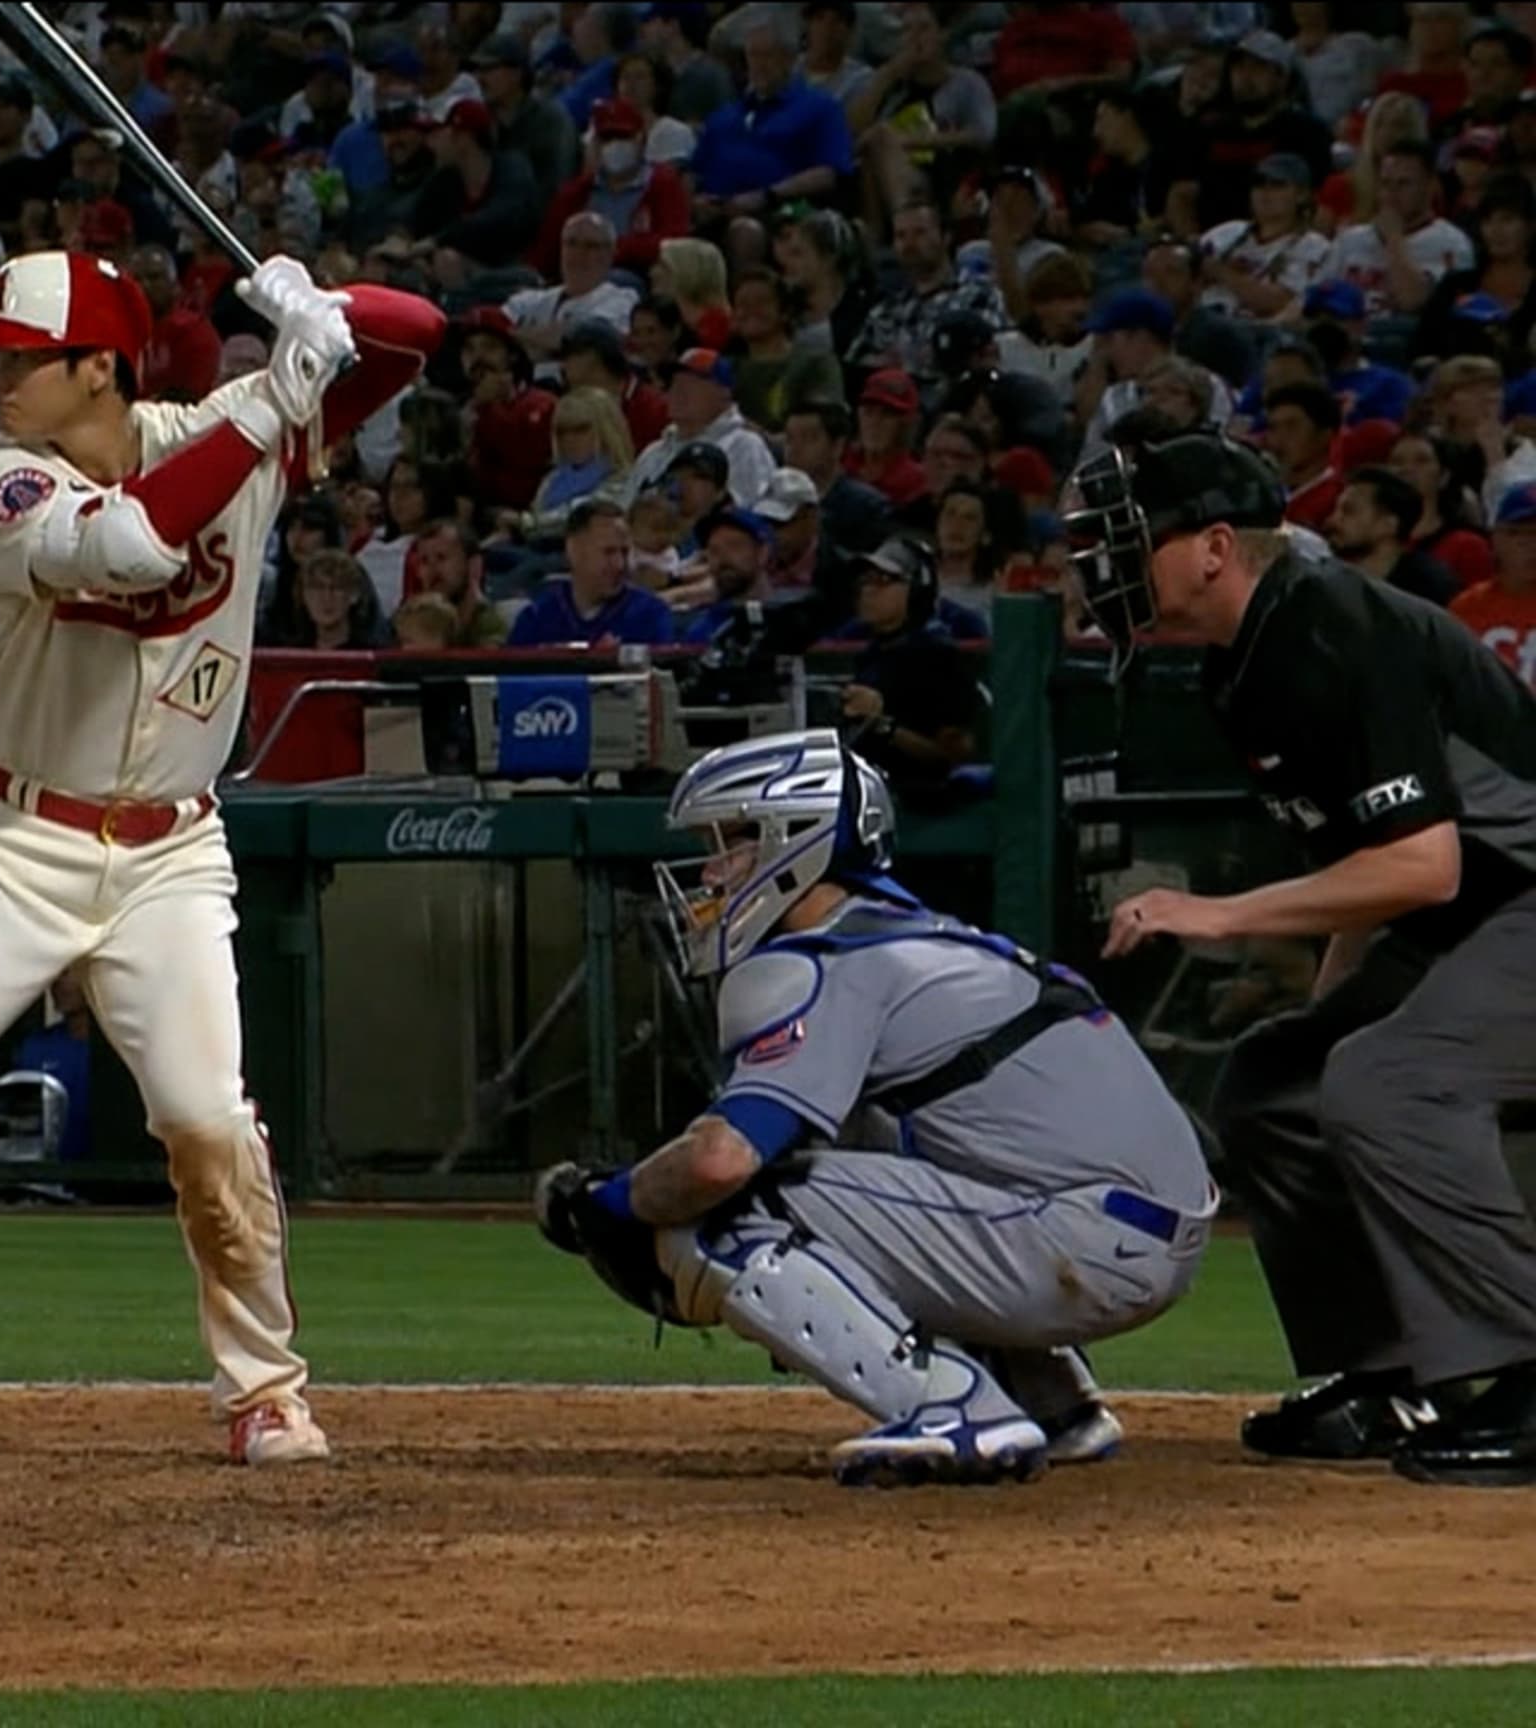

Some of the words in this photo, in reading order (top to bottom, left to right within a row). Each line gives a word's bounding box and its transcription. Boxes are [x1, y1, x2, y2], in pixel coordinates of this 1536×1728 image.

[193, 659, 220, 706] 17
[513, 705, 570, 737] SNY
[1365, 773, 1425, 816] FTX
